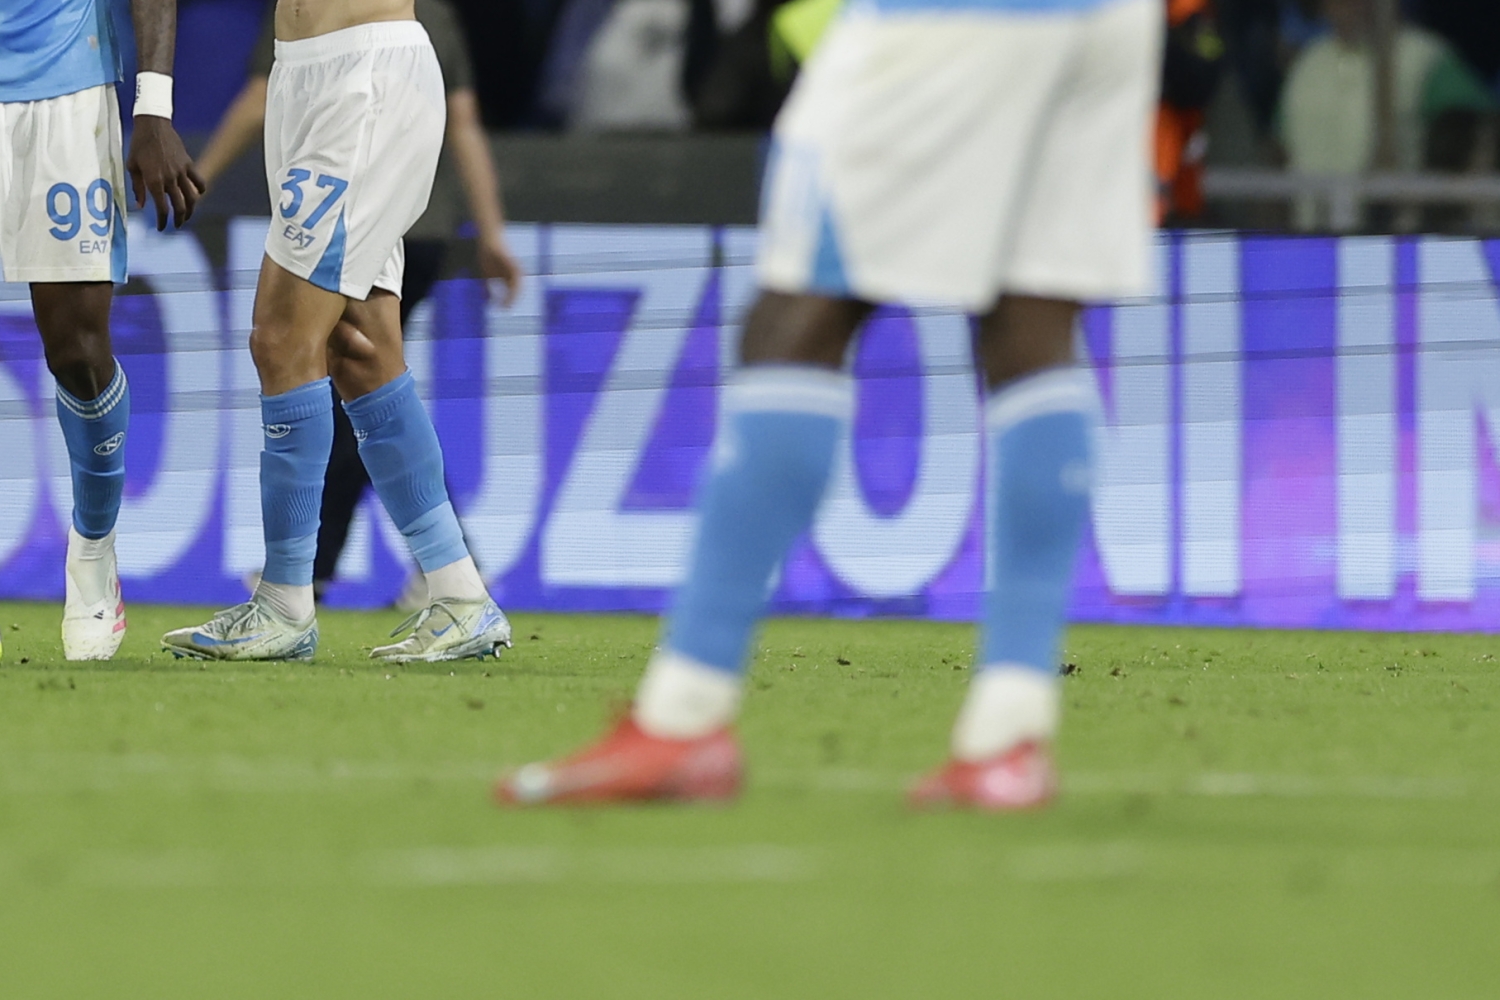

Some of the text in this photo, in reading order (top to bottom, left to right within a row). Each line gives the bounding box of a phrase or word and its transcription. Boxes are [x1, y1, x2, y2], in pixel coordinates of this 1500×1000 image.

[46, 178, 113, 241] 99
[279, 168, 349, 230] 37
[79, 240, 108, 253] EA7
[283, 225, 315, 249] EA7
